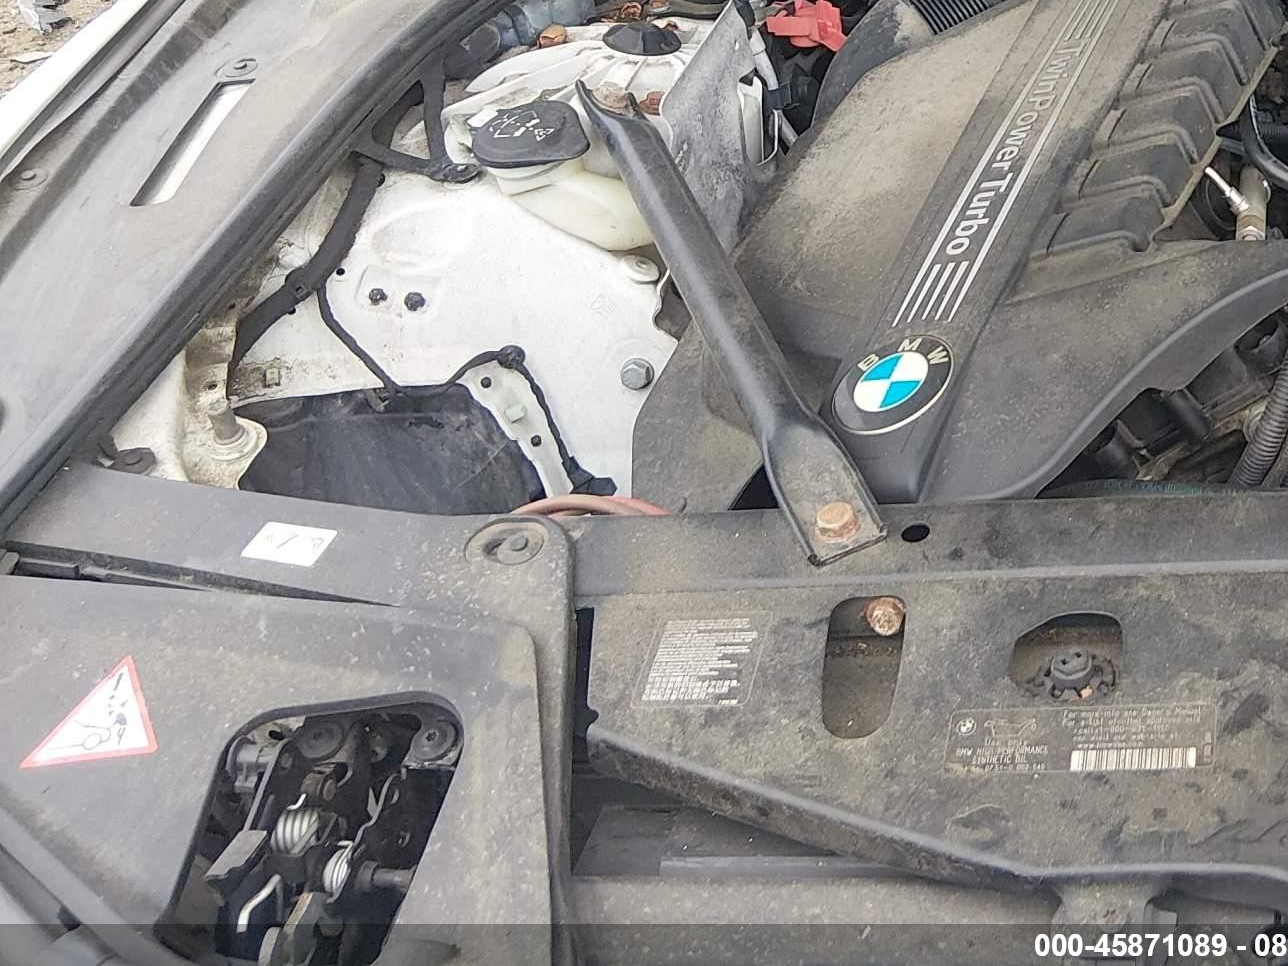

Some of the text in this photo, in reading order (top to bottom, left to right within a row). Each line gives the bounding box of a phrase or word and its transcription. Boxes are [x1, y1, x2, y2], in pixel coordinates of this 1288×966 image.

[945, 172, 1014, 255] Turbo
[857, 337, 950, 372] BMW
[956, 747, 974, 756] BMW
